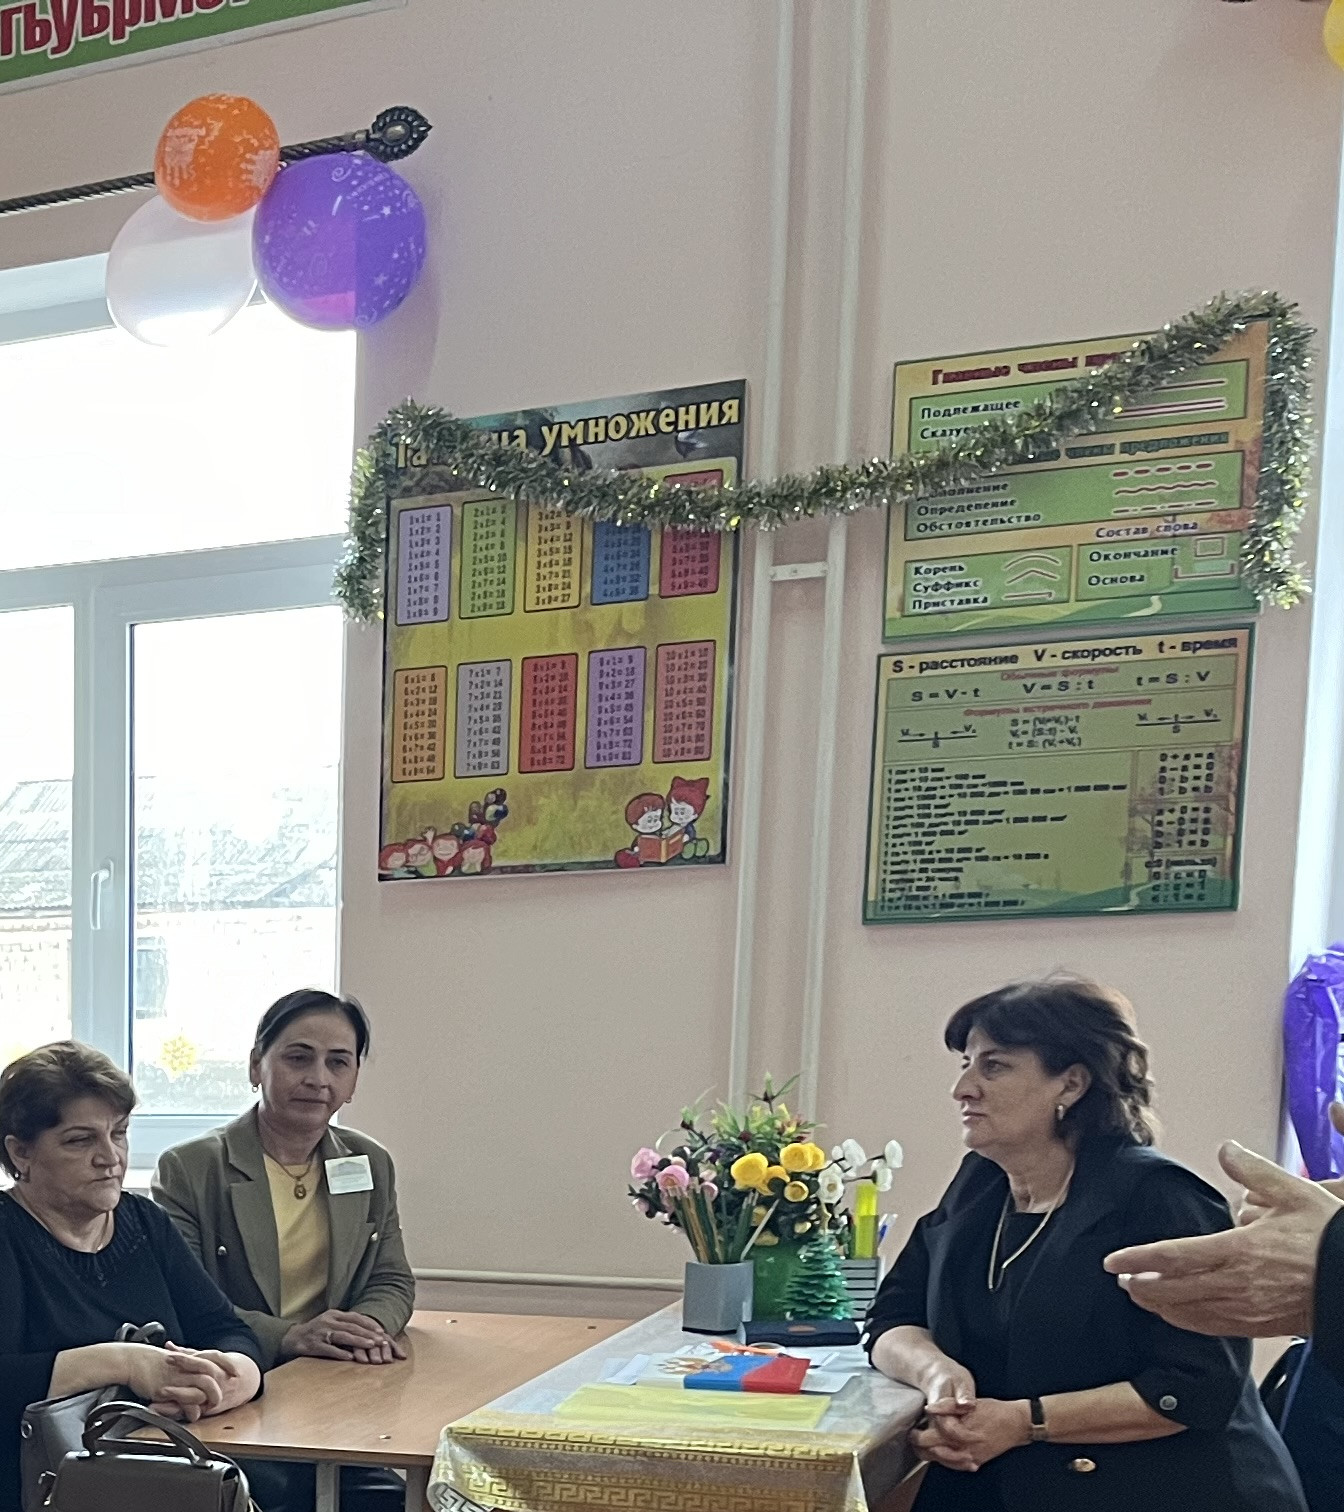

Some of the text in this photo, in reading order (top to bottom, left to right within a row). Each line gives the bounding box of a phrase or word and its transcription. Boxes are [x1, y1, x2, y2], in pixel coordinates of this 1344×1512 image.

[921, 399, 1021, 420] Подлежащее
[541, 398, 741, 457] умножения
[1089, 546, 1178, 563] Окончание
[914, 564, 965, 578] Корень
[913, 579, 980, 595] Суффикс
[1088, 573, 1145, 587] Основа
[913, 595, 988, 611] Приставка
[892, 660, 904, 673] S
[919, 653, 1018, 674] расстояние
[1034, 649, 1048, 662] V
[1062, 644, 1143, 662] скорость
[1157, 639, 1165, 653] t
[1181, 636, 1237, 652] время
